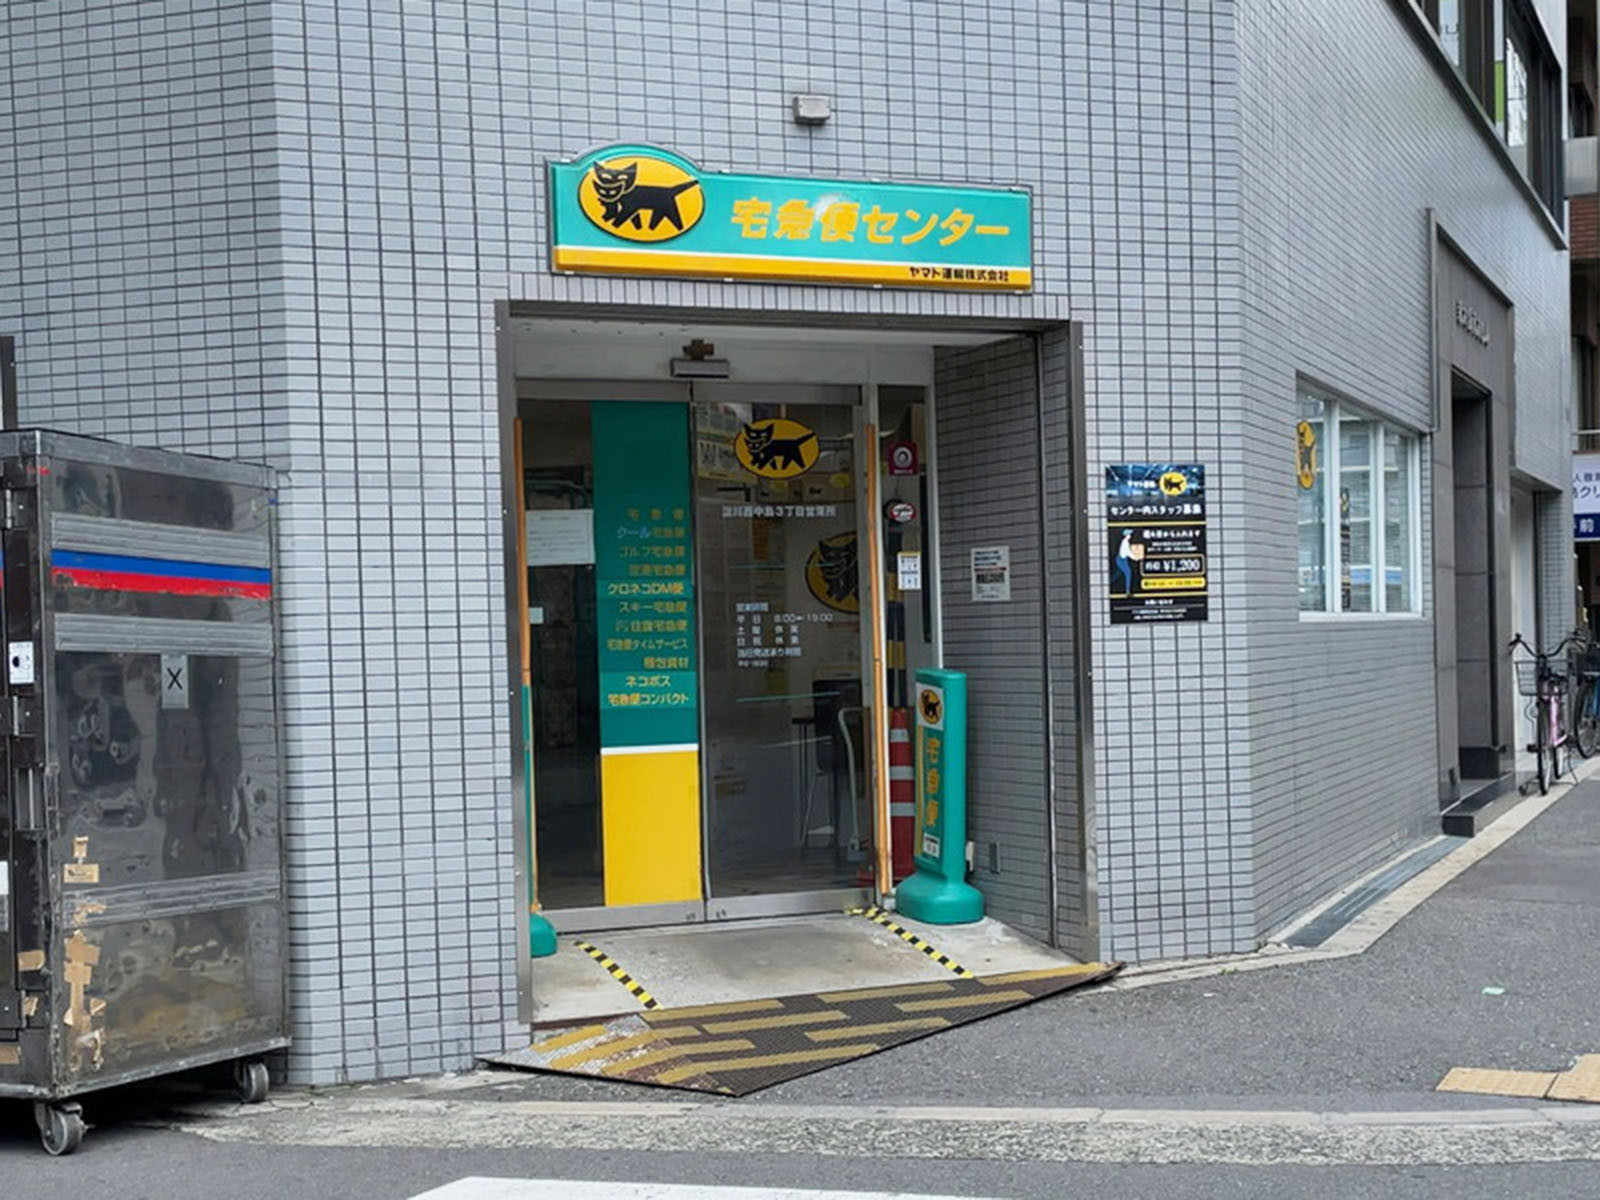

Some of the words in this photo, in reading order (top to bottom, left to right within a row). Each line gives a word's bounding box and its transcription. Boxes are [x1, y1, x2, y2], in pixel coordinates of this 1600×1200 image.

[730, 197, 1010, 247] 宅急便センター
[909, 266, 1009, 282] ヤマト運輸株式会社
[608, 583, 684, 596] クロネコDM便
[619, 601, 688, 613] スキー宅急便
[625, 674, 671, 688] ネコポス
[607, 693, 689, 707] 宅急便コンパクト
[925, 737, 941, 828] 宅急便
